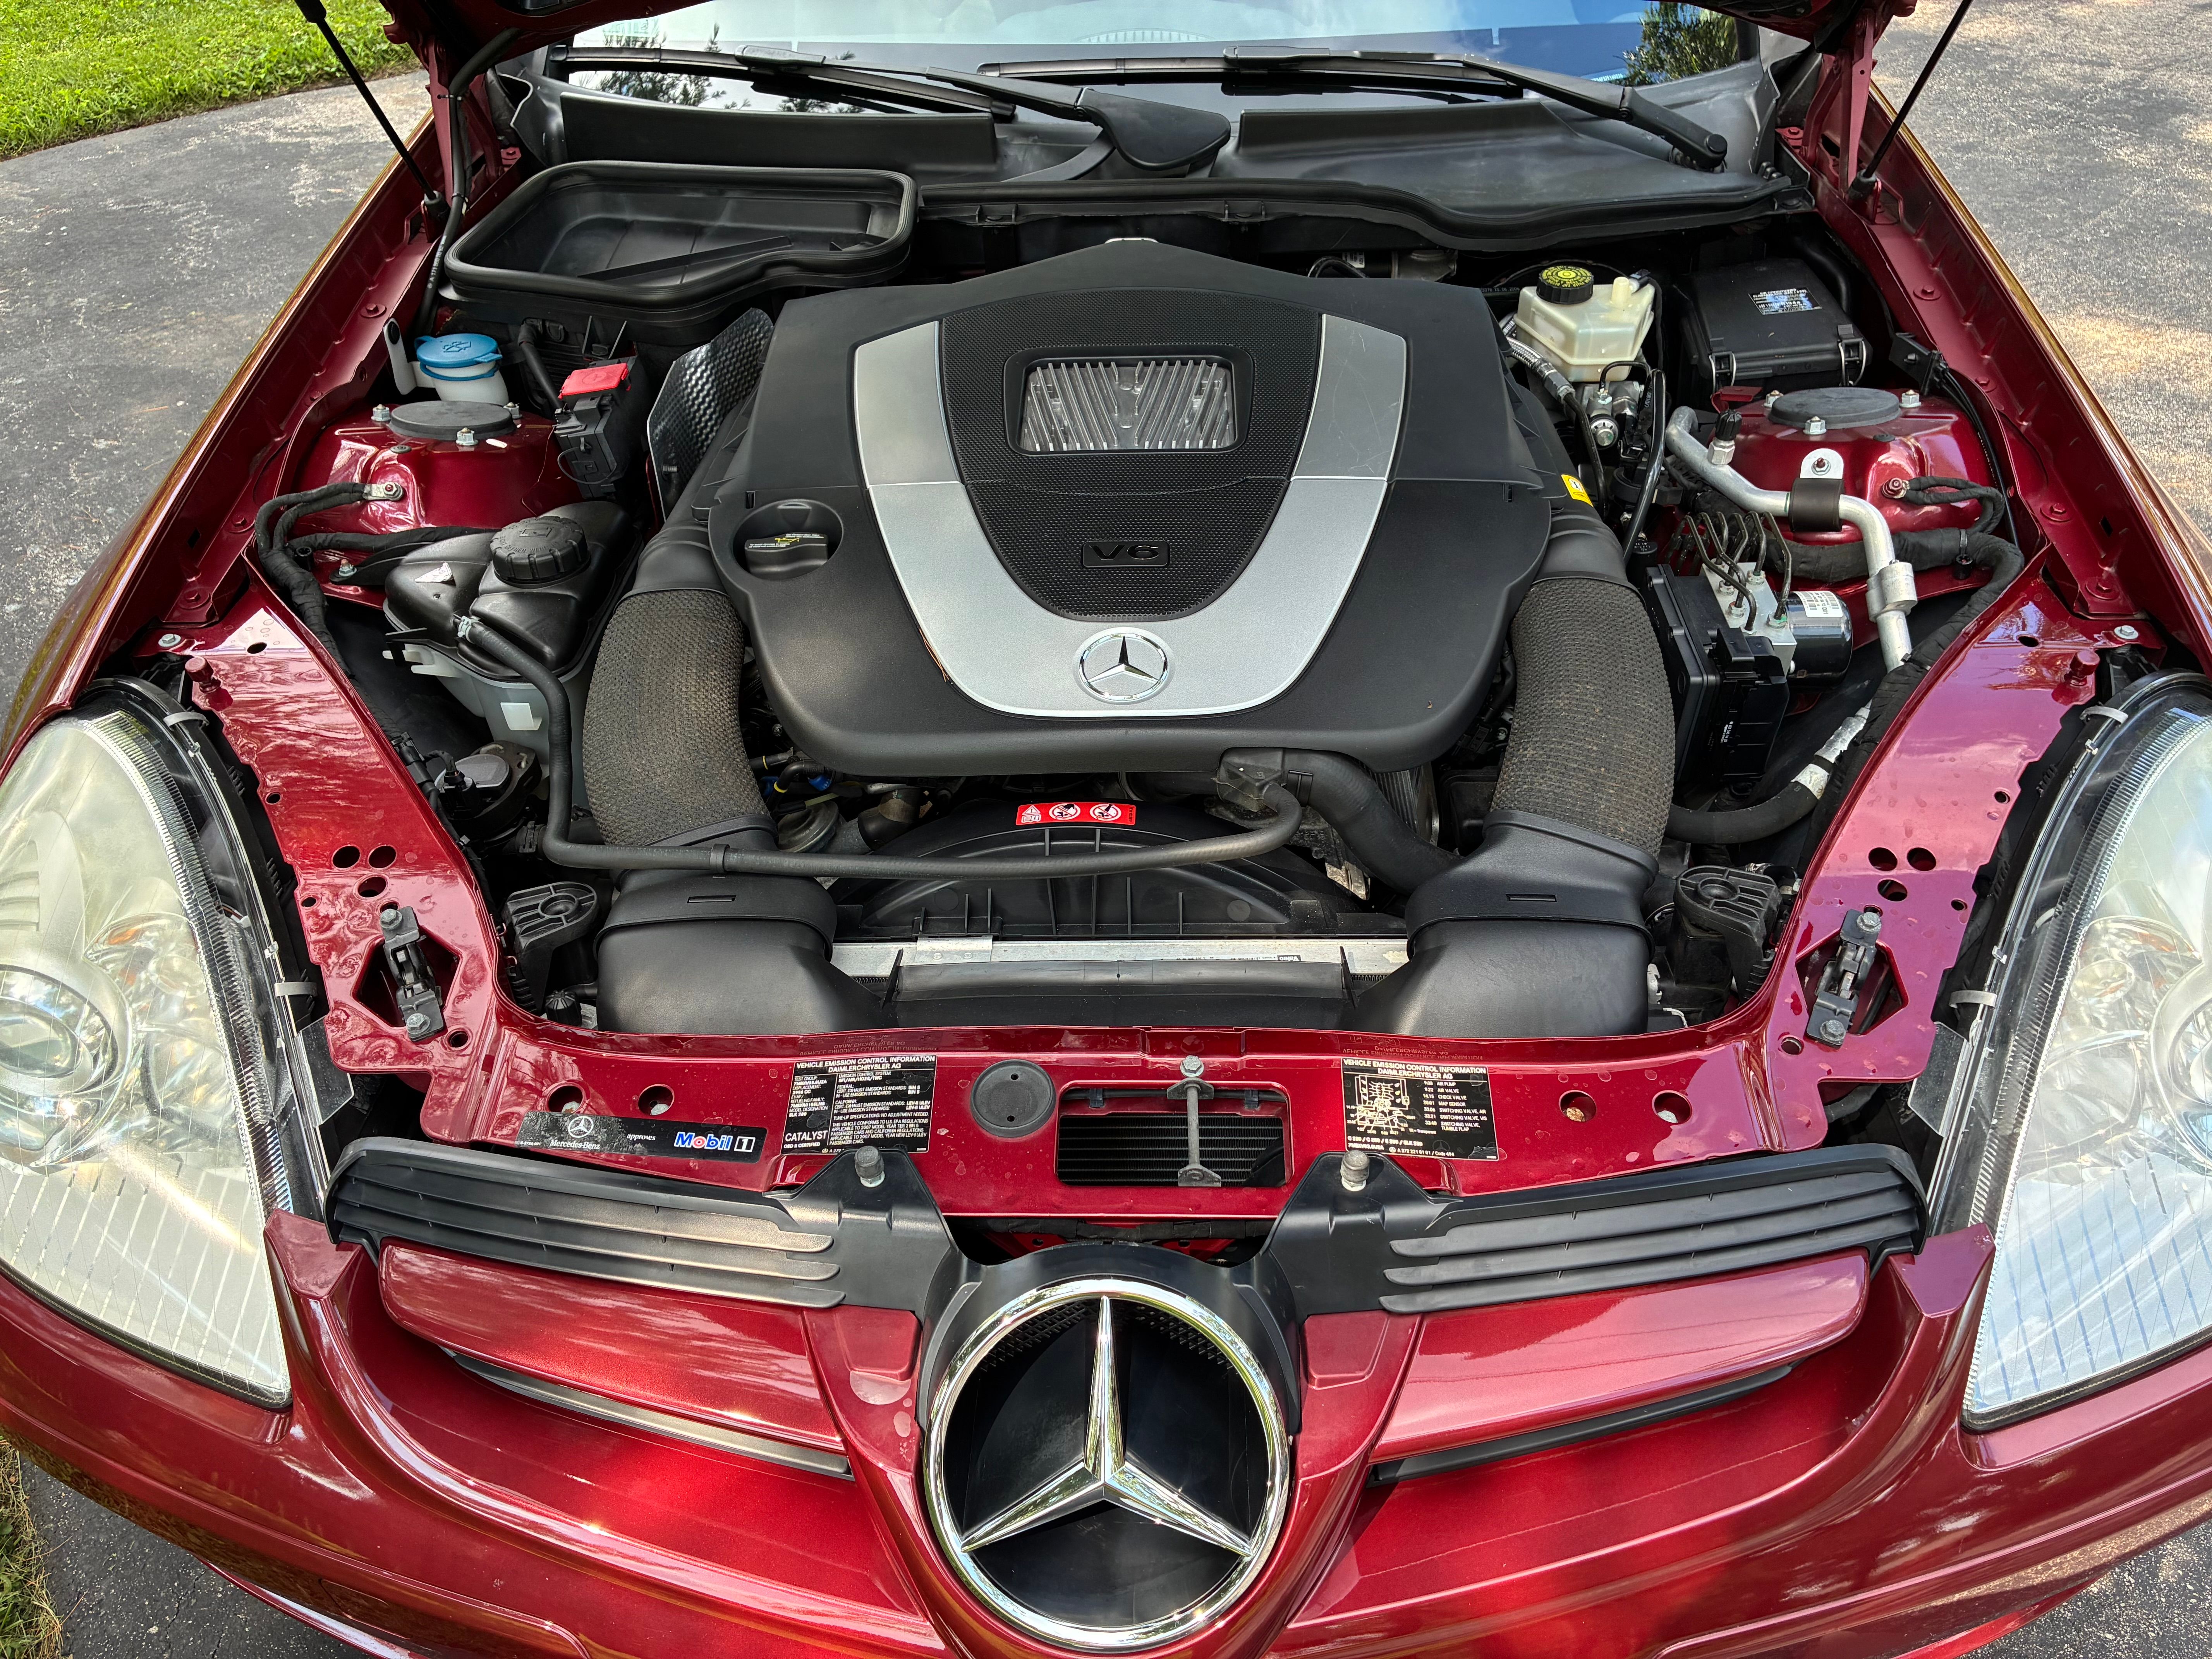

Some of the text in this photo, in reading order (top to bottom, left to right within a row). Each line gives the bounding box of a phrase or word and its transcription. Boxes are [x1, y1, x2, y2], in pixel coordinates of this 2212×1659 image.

[1089, 545, 1160, 560] V6
[828, 1064, 890, 1072] DAIMLERCHRYSLER
[1372, 1061, 1405, 1069] EMISSION
[1407, 1064, 1438, 1072] CONTROL
[1439, 1066, 1486, 1074] INFORMATION
[1378, 1068, 1442, 1079] DAIMLERCHRYSLER
[673, 1131, 733, 1151] Mobil
[785, 1130, 828, 1142] CATALYST
[550, 1139, 600, 1149] Mercedes-Benz
